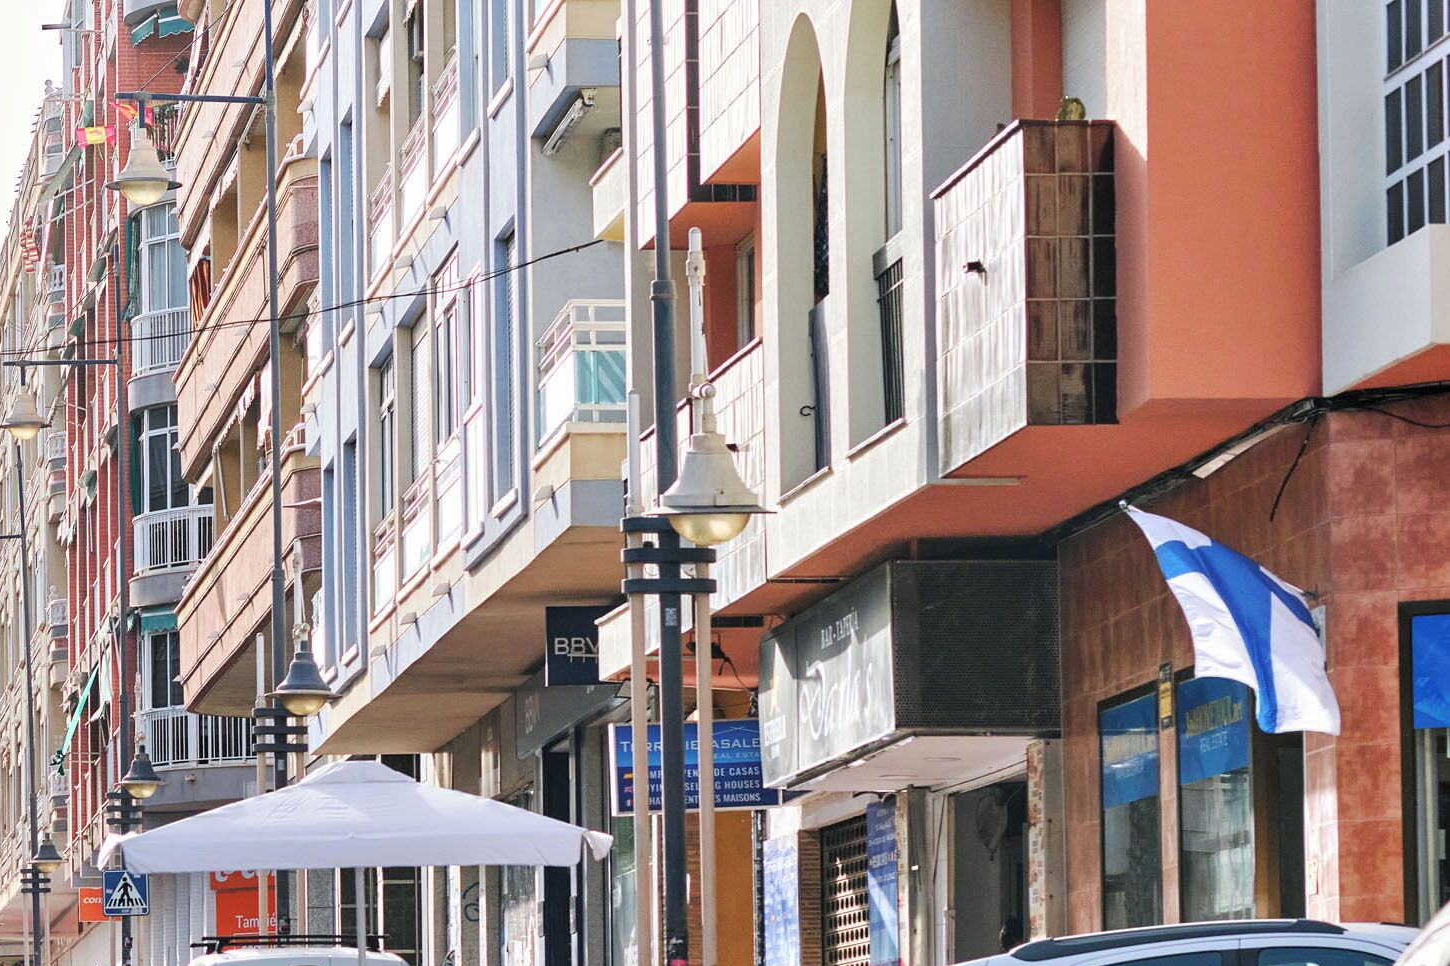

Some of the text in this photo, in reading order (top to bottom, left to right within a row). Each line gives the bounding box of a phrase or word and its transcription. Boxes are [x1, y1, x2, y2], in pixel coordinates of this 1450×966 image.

[554, 637, 599, 655] BBV
[714, 751, 760, 760] EAL ESTA
[714, 766, 760, 776] DE CASAS
[724, 779, 760, 790] HOUSES
[723, 793, 761, 803] MAISONS
[82, 896, 104, 904] con
[235, 913, 276, 929] Tamié
